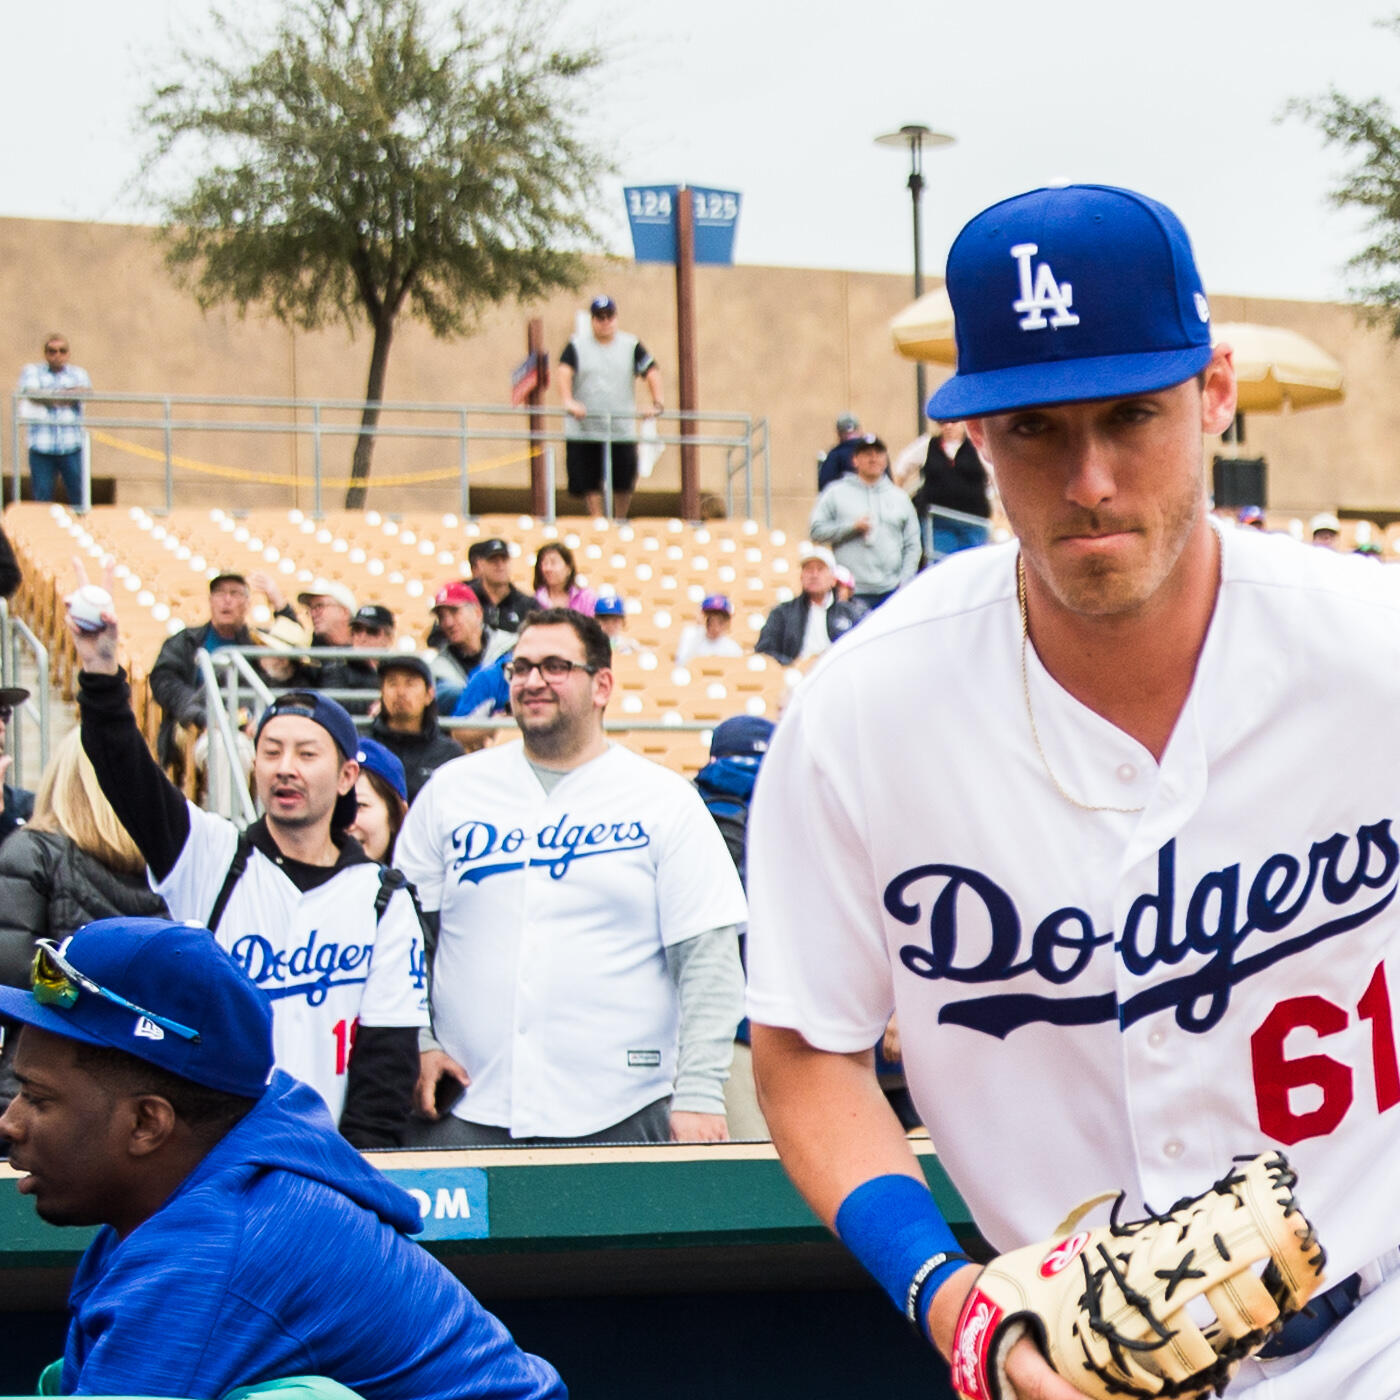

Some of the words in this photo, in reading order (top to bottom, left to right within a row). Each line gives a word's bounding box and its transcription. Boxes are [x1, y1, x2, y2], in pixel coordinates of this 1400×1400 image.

[629, 189, 672, 217] 124
[695, 192, 738, 219] 125
[1010, 242, 1081, 331] LA
[452, 813, 650, 881] Dodgers
[884, 818, 1400, 1036] Dodgers
[232, 929, 374, 1007] Dodger
